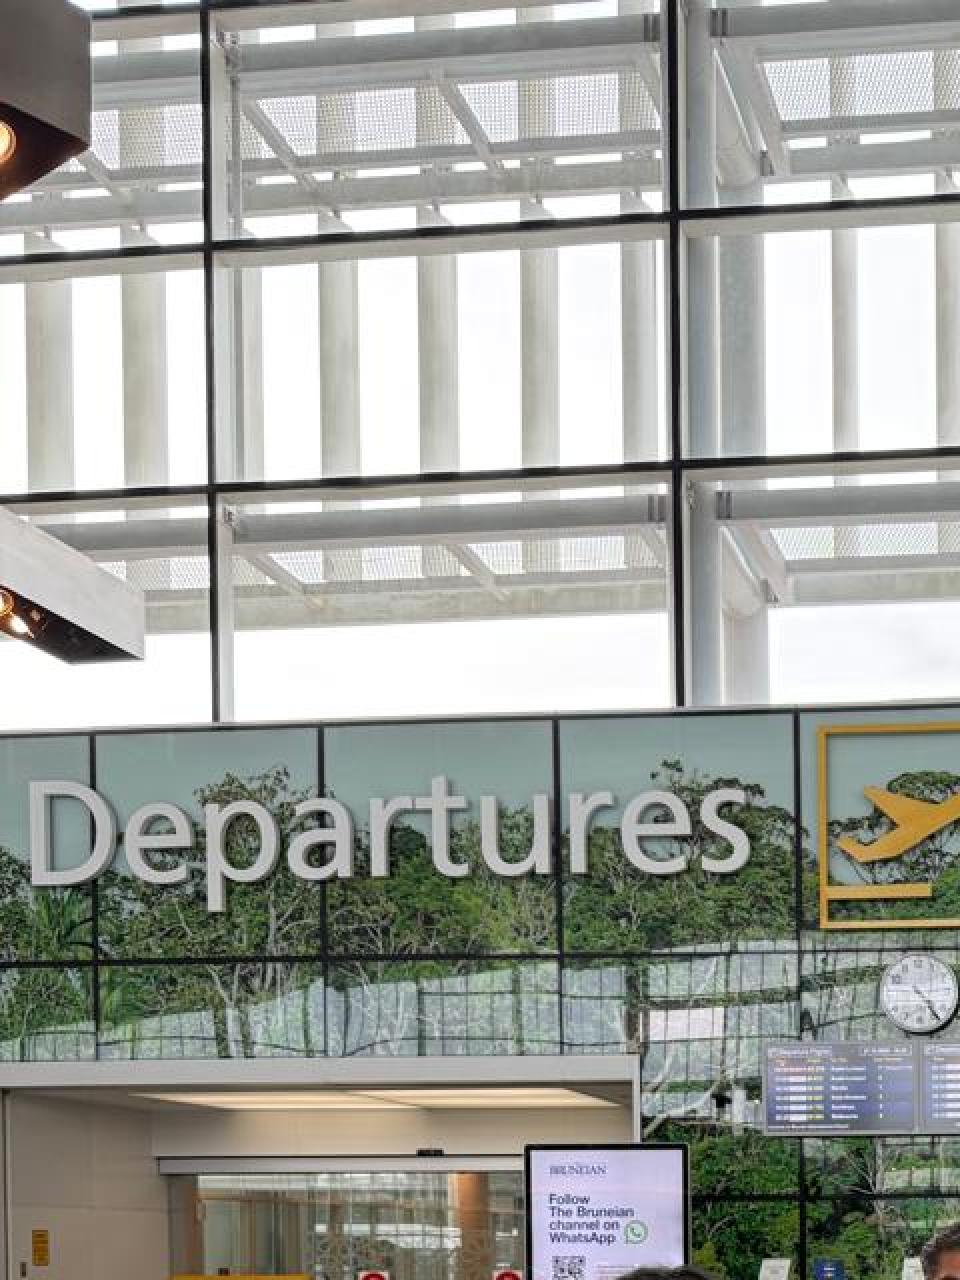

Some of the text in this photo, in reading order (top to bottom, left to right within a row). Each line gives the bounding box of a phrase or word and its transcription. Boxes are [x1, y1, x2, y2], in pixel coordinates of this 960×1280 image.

[28, 775, 752, 912] Departures
[549, 1193, 590, 1205] Follow
[549, 1205, 635, 1217] The Bruneian
[549, 1219, 620, 1231] channel on
[549, 1232, 617, 1246] WhatsApp
